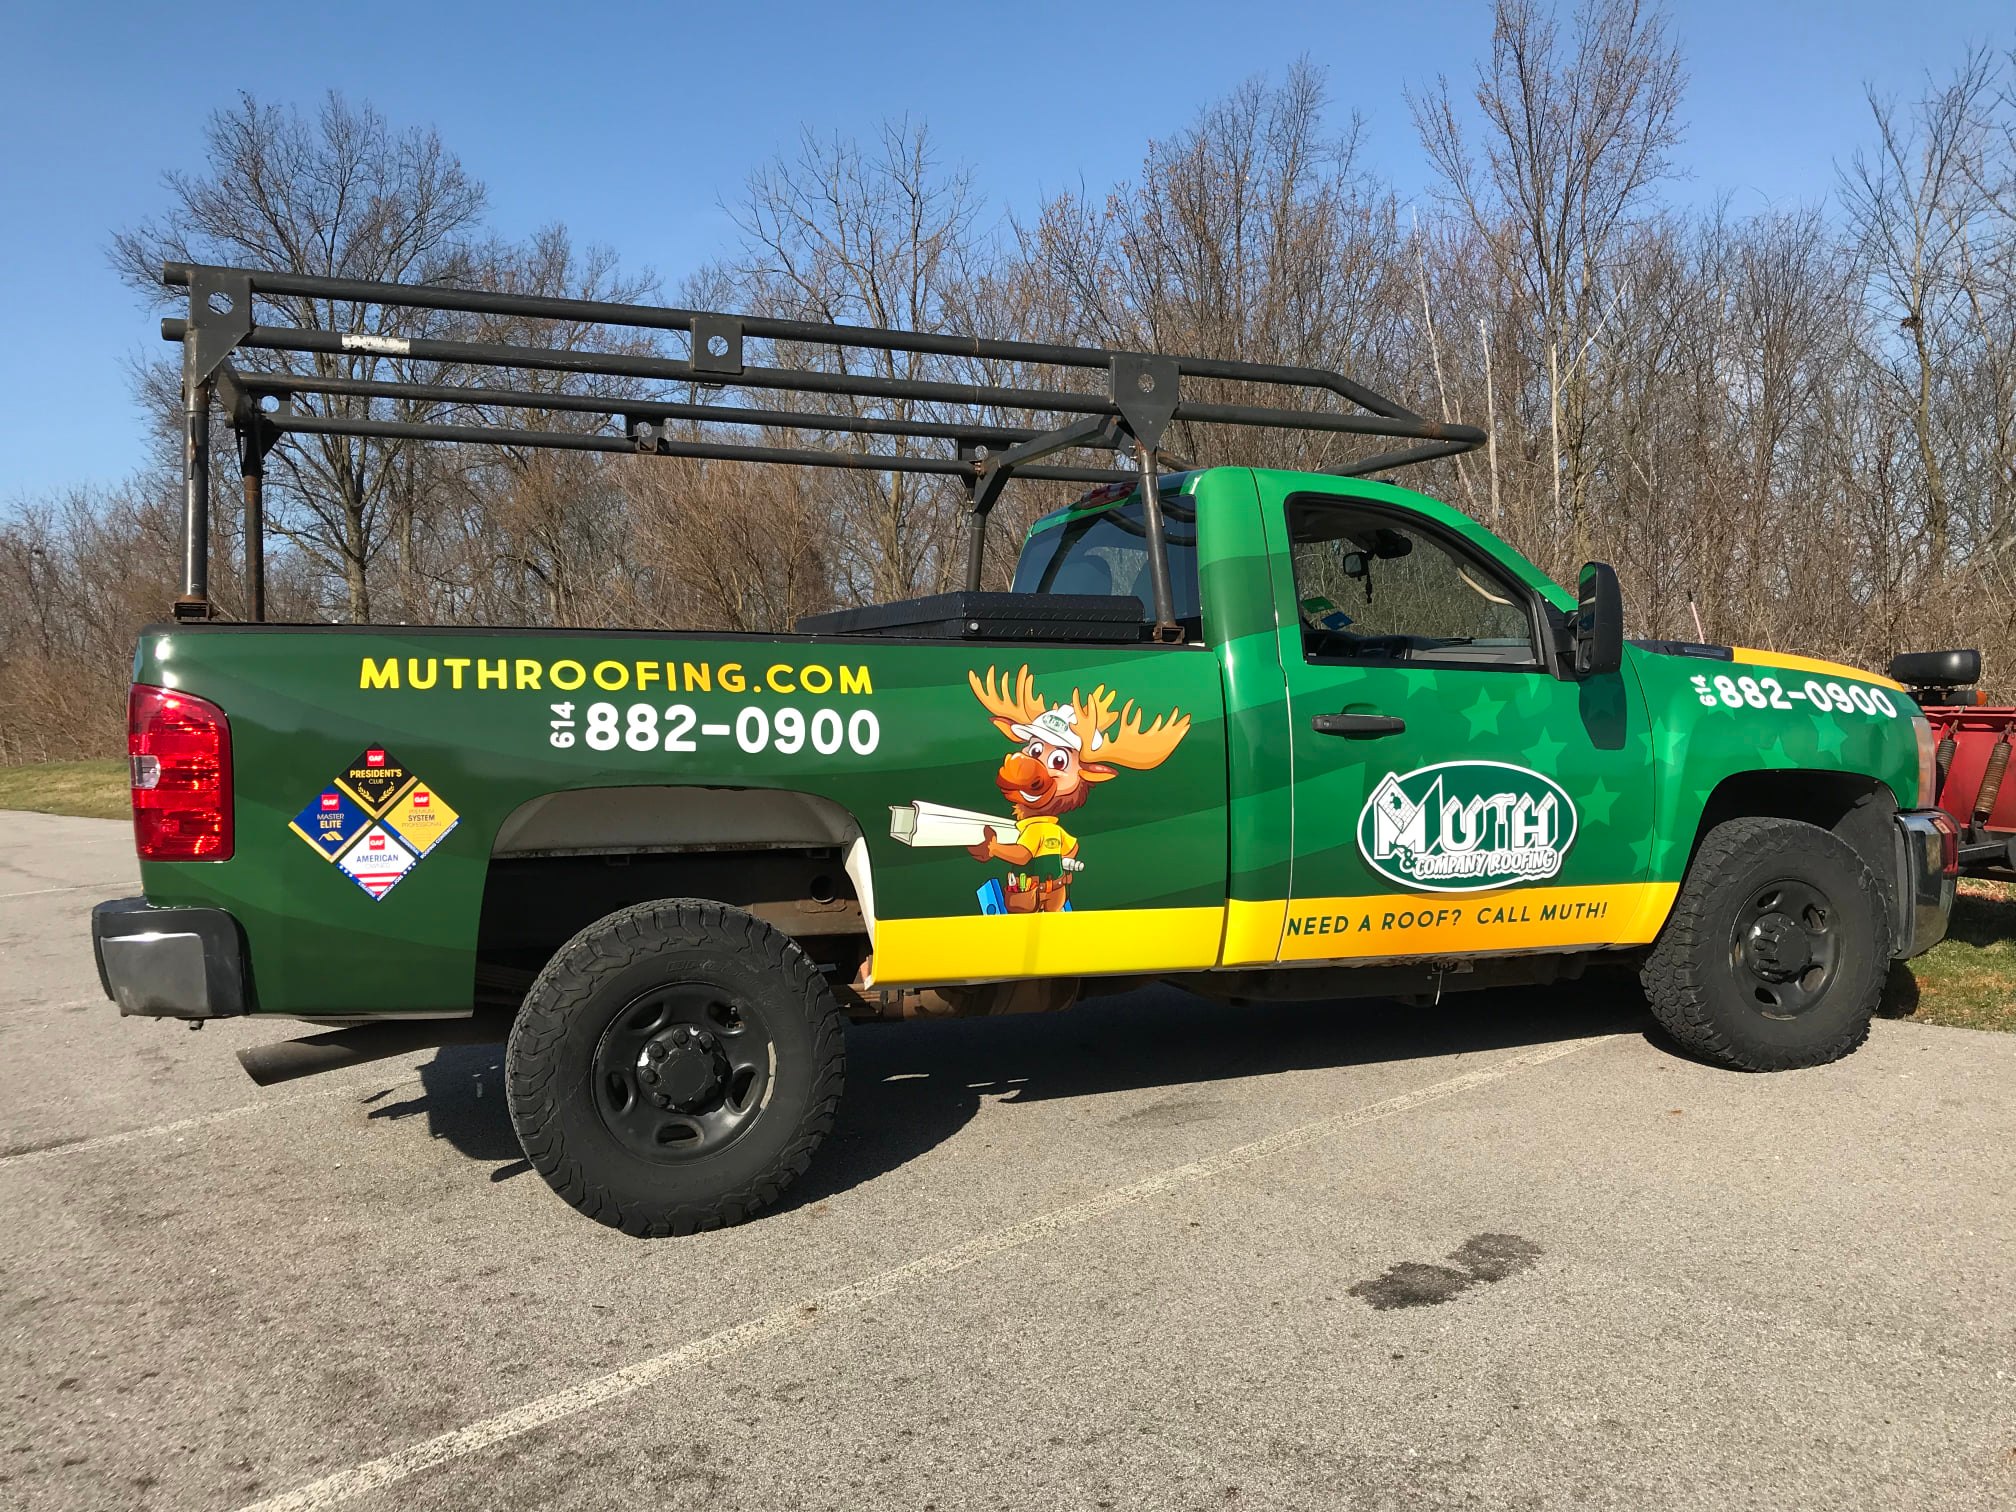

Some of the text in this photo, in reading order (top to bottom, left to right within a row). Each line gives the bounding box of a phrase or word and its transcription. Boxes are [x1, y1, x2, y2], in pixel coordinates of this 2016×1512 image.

[359, 657, 874, 695] MUTHROOFING.COM
[1690, 674, 1898, 719] 614 882-0900
[550, 701, 880, 756] 614 882-0900
[350, 769, 402, 778] PRESIDENT'S
[320, 820, 342, 829] ELITE
[1376, 776, 1558, 858] MUTH
[356, 854, 399, 862] AMERICAN
[1415, 853, 1490, 876] COMPANY
[1489, 849, 1555, 873] ROOFING
[1287, 902, 1608, 936] NEED A ROOF? CALL MUTH!
